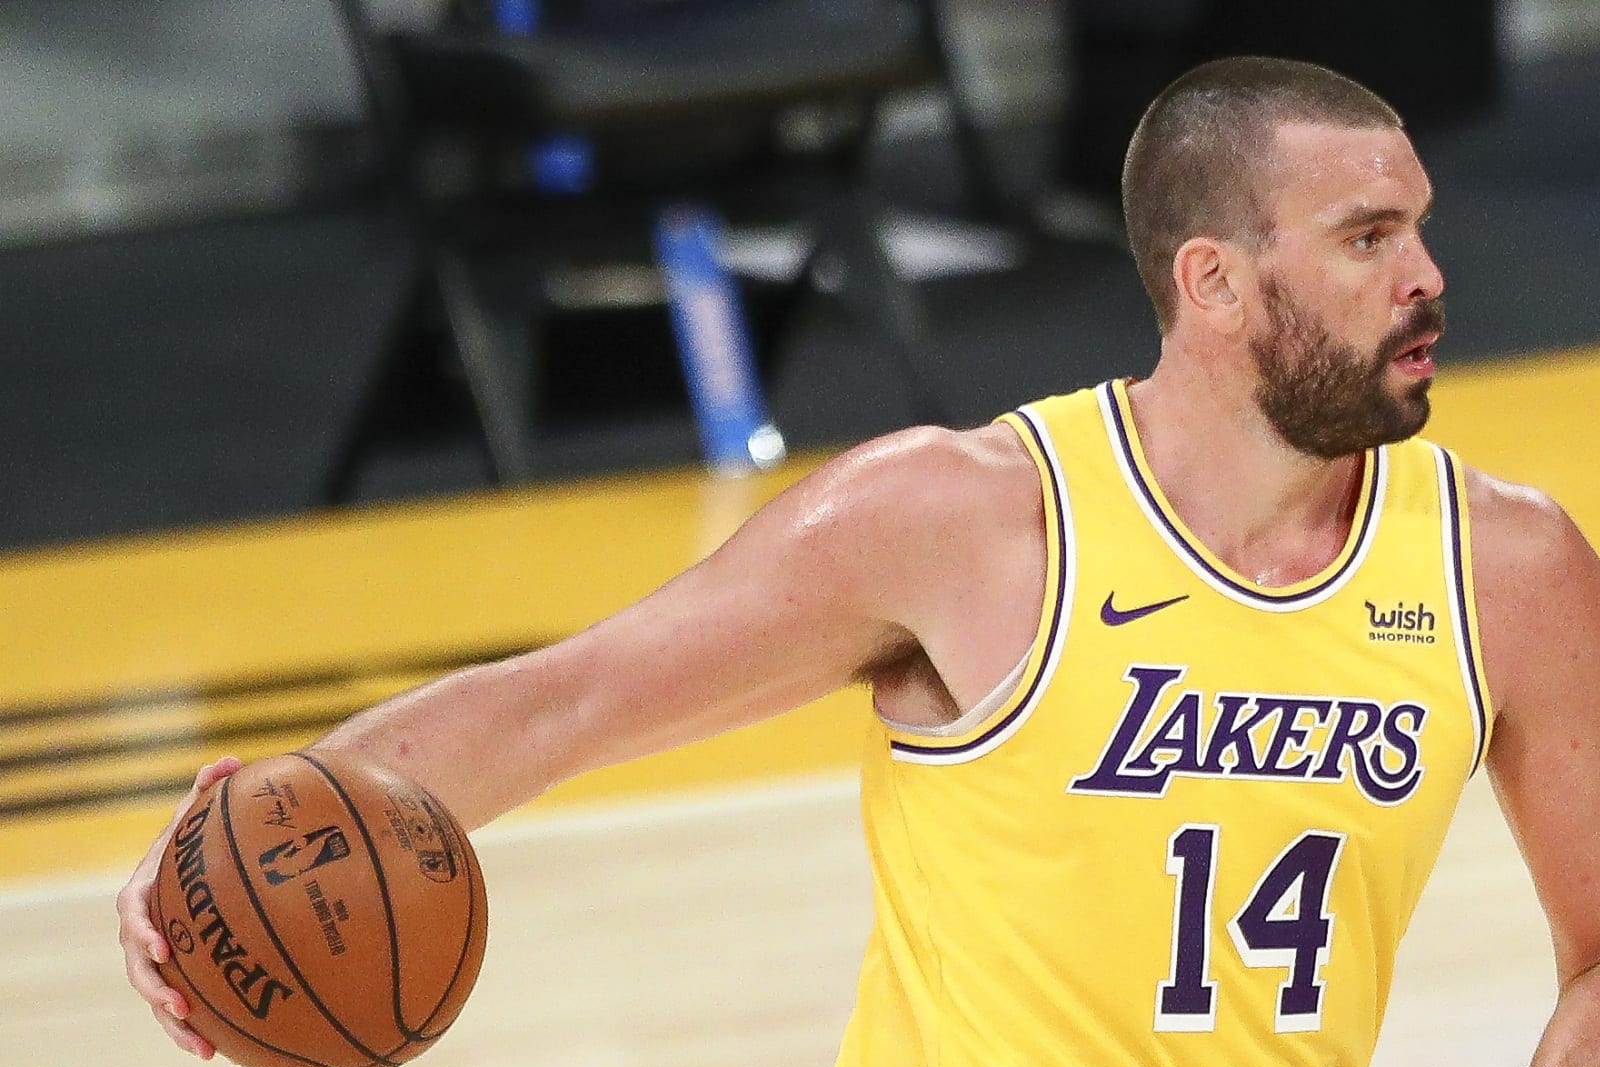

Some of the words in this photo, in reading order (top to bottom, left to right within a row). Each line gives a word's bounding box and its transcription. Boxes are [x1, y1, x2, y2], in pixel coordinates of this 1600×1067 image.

[1365, 601, 1436, 632] wish
[1368, 632, 1436, 644] SHOPPING
[1065, 662, 1430, 807] LAKERS
[173, 799, 293, 1019] SPALDING
[1153, 822, 1348, 1034] 14
